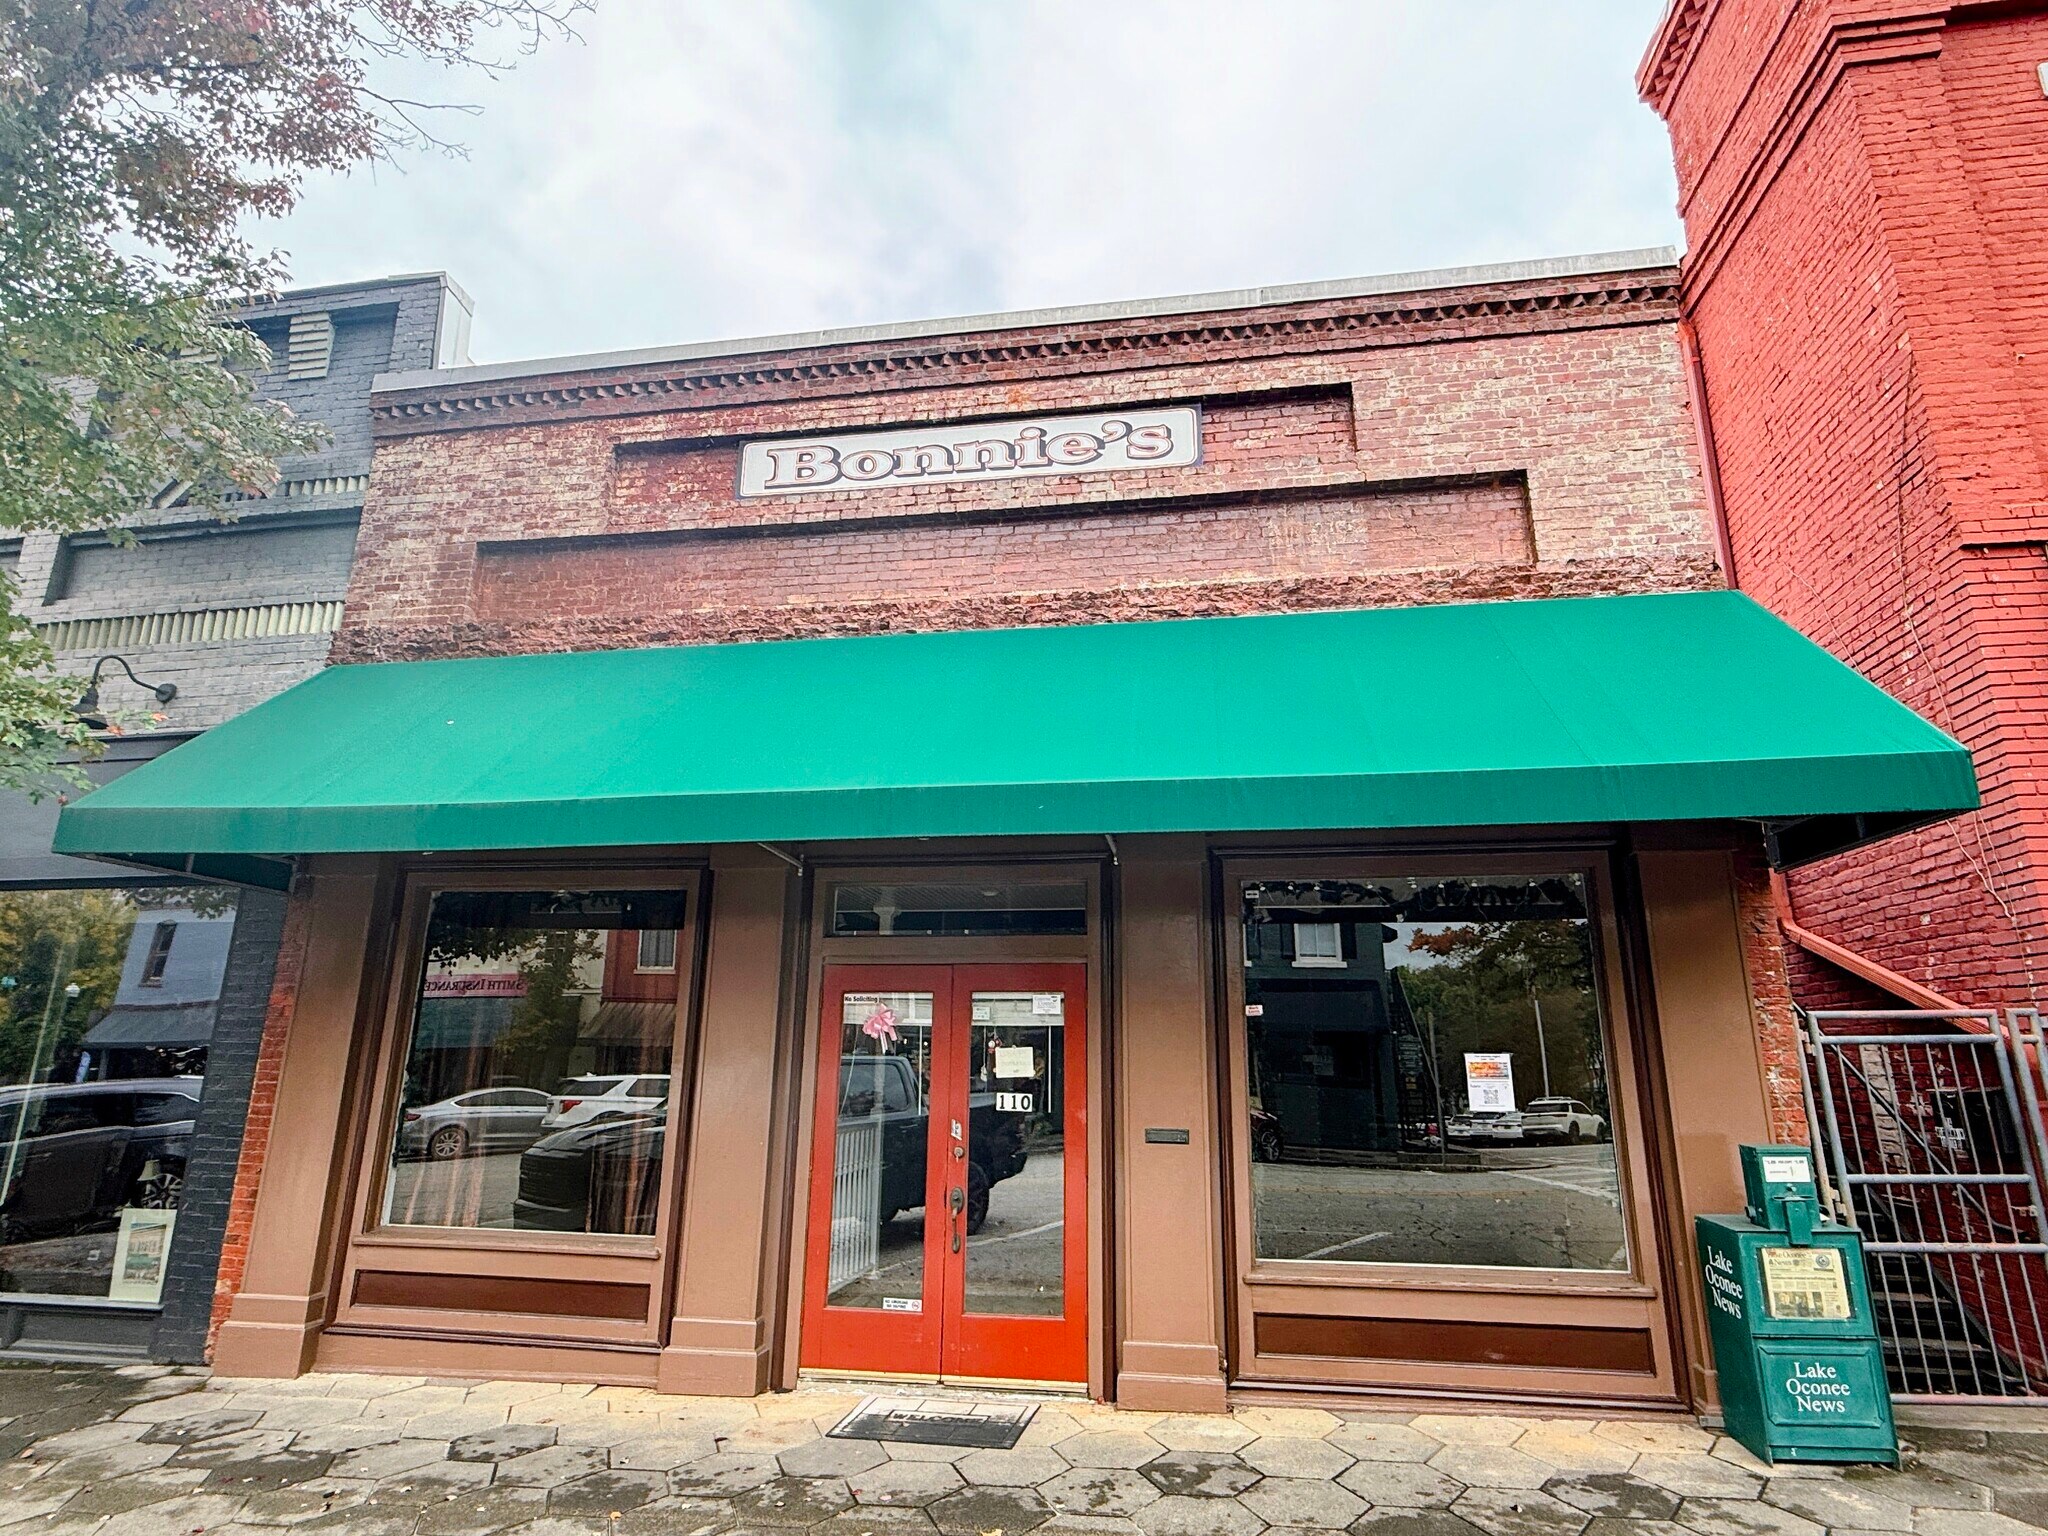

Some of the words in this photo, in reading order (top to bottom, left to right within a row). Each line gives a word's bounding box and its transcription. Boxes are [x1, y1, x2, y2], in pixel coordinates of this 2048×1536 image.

[763, 419, 1174, 489] Bonnie's
[999, 1095, 1030, 1110] 110
[1707, 1245, 1733, 1275] Lake
[1705, 1264, 1743, 1300] Oconee
[1711, 1286, 1742, 1319] News
[1794, 1361, 1837, 1379] Lake
[1786, 1378, 1851, 1396] Oconee
[1795, 1395, 1846, 1413] News
